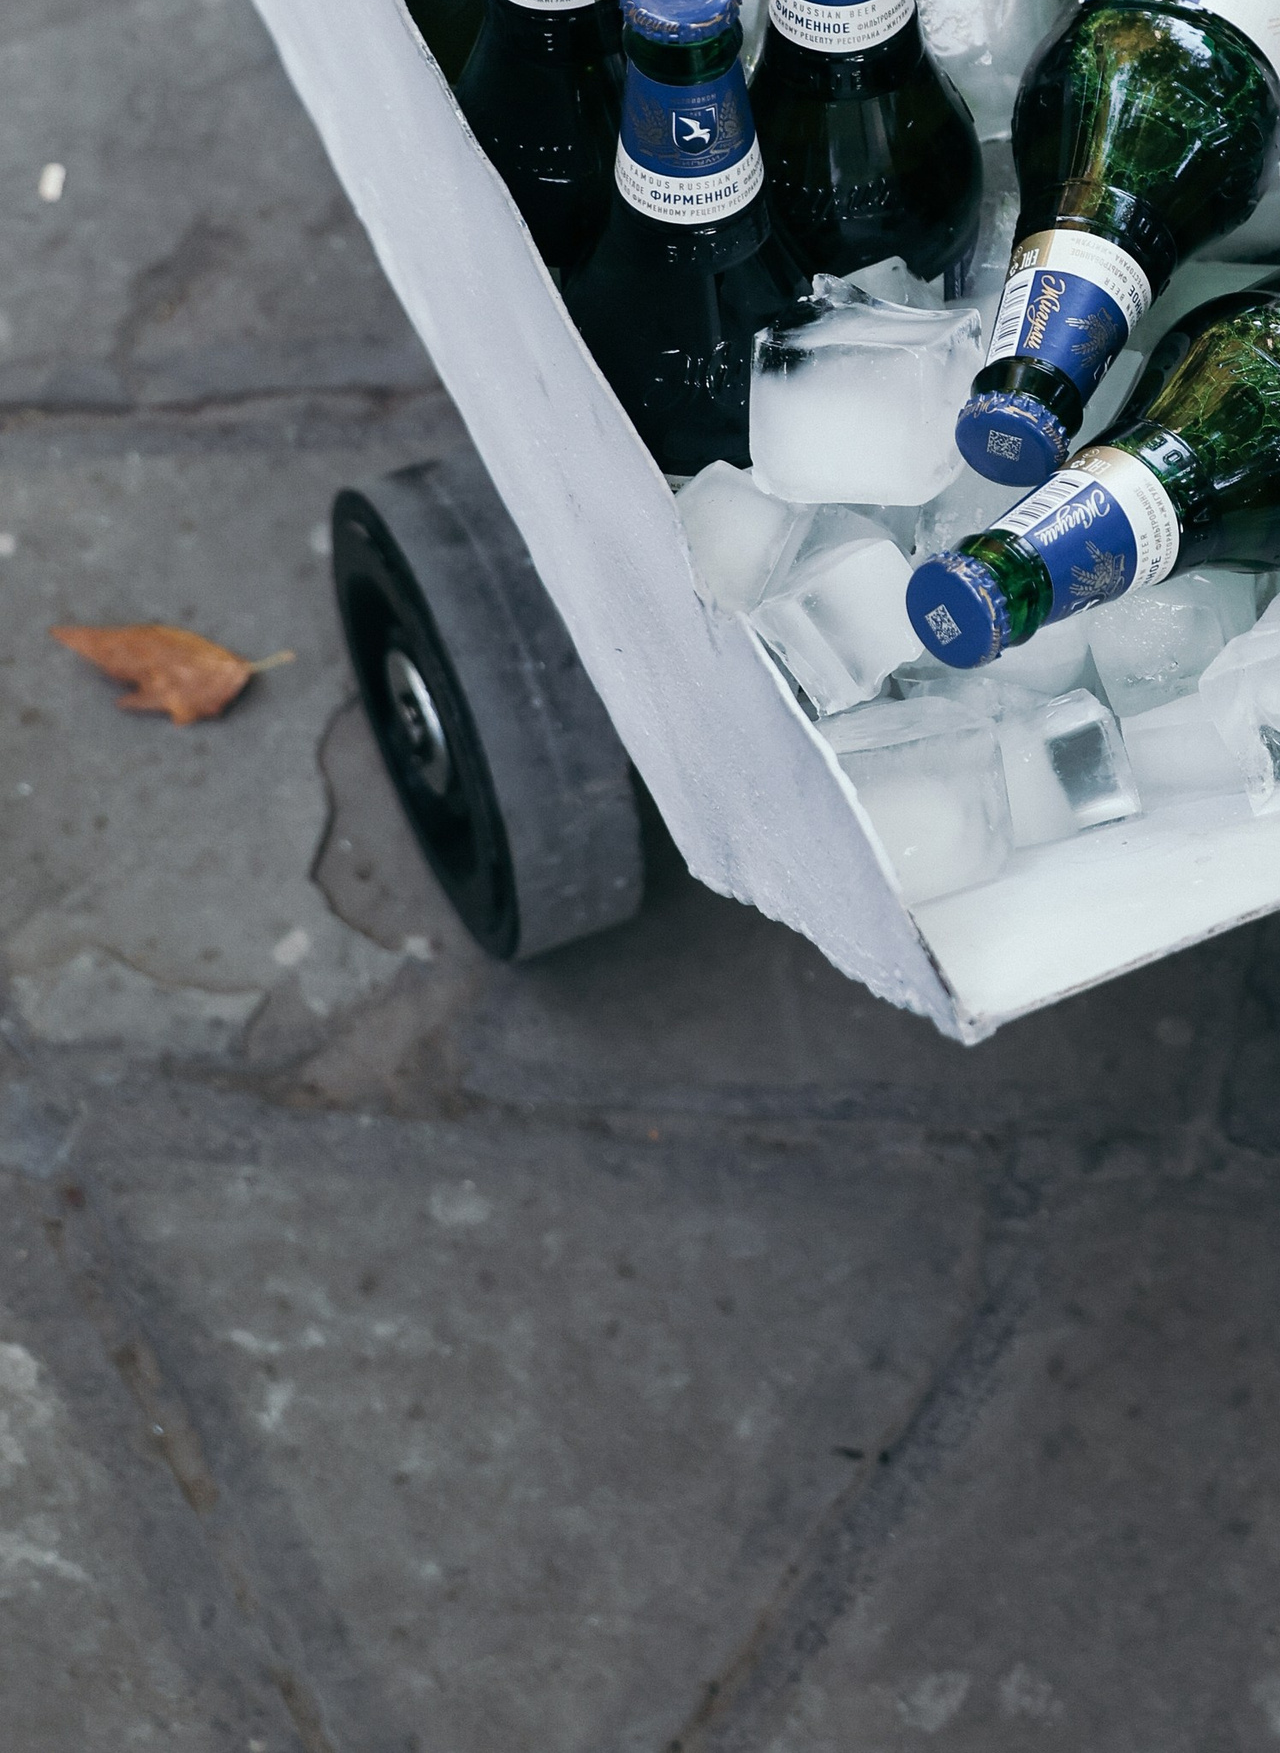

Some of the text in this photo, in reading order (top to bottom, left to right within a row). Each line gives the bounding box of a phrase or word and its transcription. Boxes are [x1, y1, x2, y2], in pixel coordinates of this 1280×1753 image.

[775, 0, 850, 34] ФИРМЕННОЕ
[793, 1, 877, 19] RUSSIAN BEER
[800, 31, 834, 45] РЕЦЕПТУ
[836, 29, 880, 45] РЕСТОРАНА
[630, 165, 670, 189] FAMOUS
[679, 174, 731, 191] RUSSIAN
[736, 153, 754, 176] BEER
[632, 195, 687, 217] ФИРМЕННОМУ
[690, 202, 726, 217] РЕЦЕПТУ
[650, 181, 739, 206] ФИРМЕННОЕ
[1023, 274, 1066, 350] Жигули
[1034, 489, 1110, 546] Жигули
